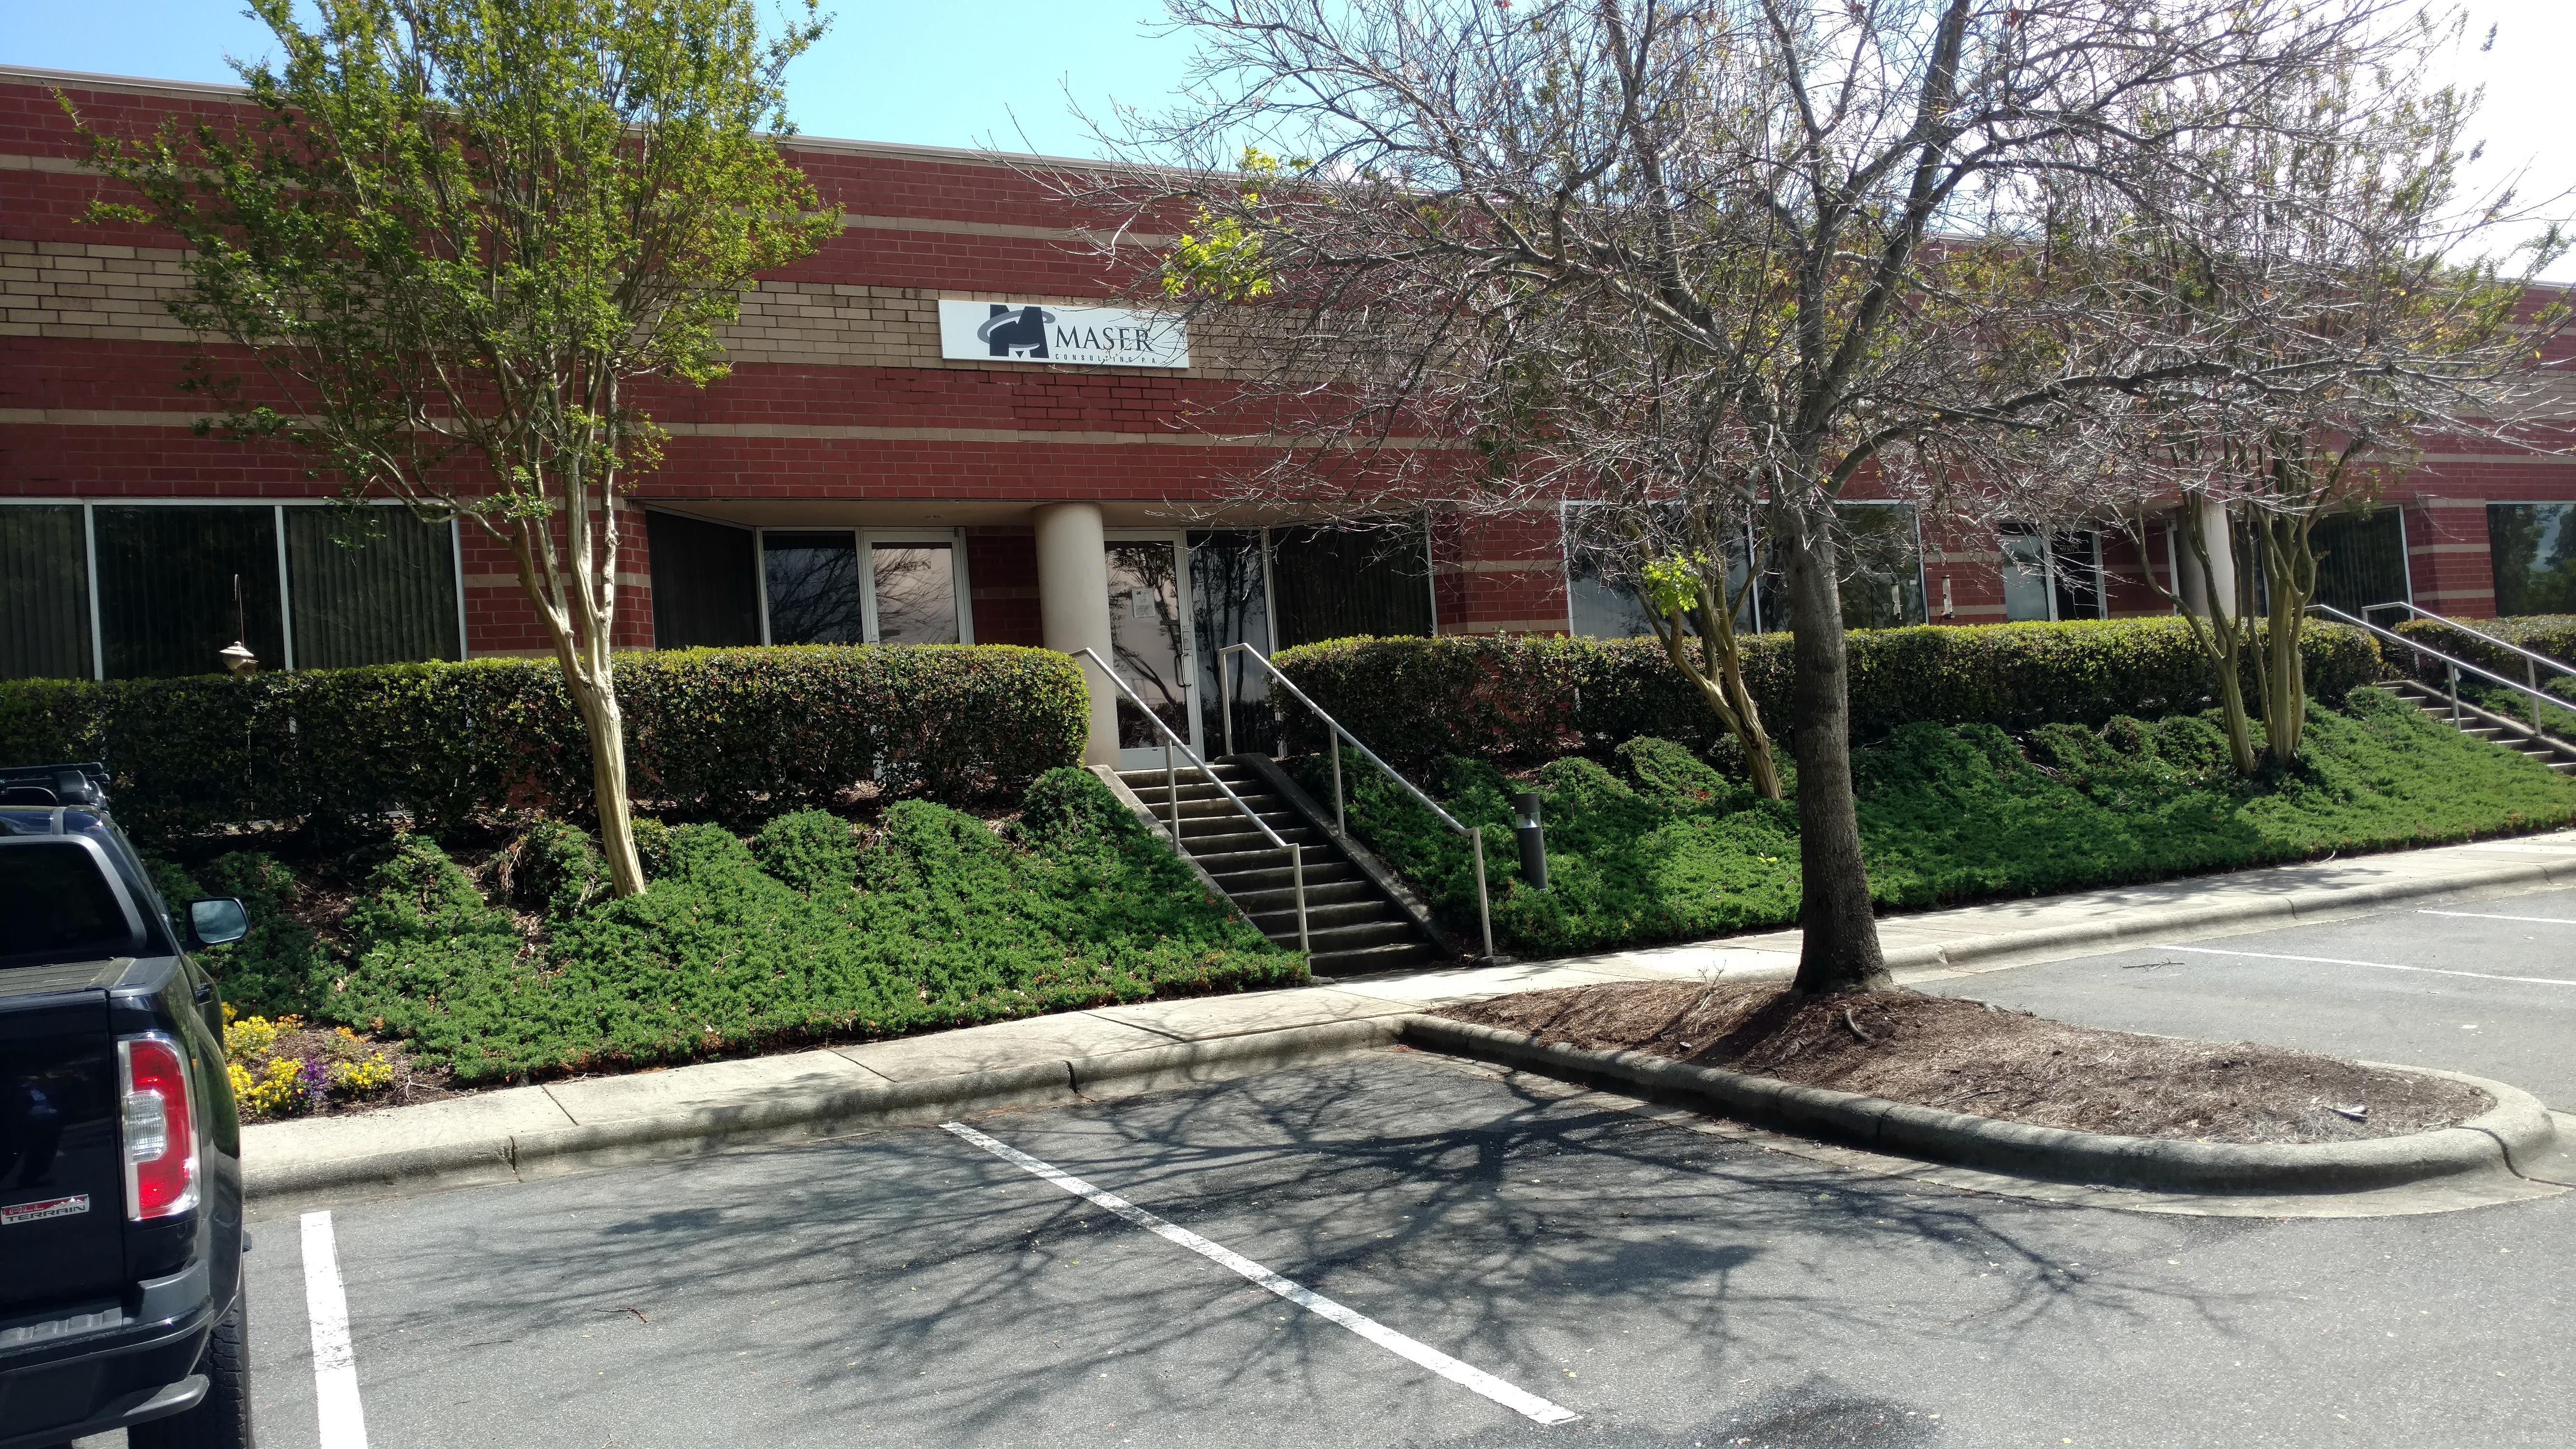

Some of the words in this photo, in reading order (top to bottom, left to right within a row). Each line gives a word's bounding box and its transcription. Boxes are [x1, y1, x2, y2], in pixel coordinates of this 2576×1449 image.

[1054, 325, 1155, 352] MASER
[1055, 353, 1132, 362] CONSULTING
[5, 1205, 85, 1222] TERRAIN
[9, 1204, 44, 1215] ALL
